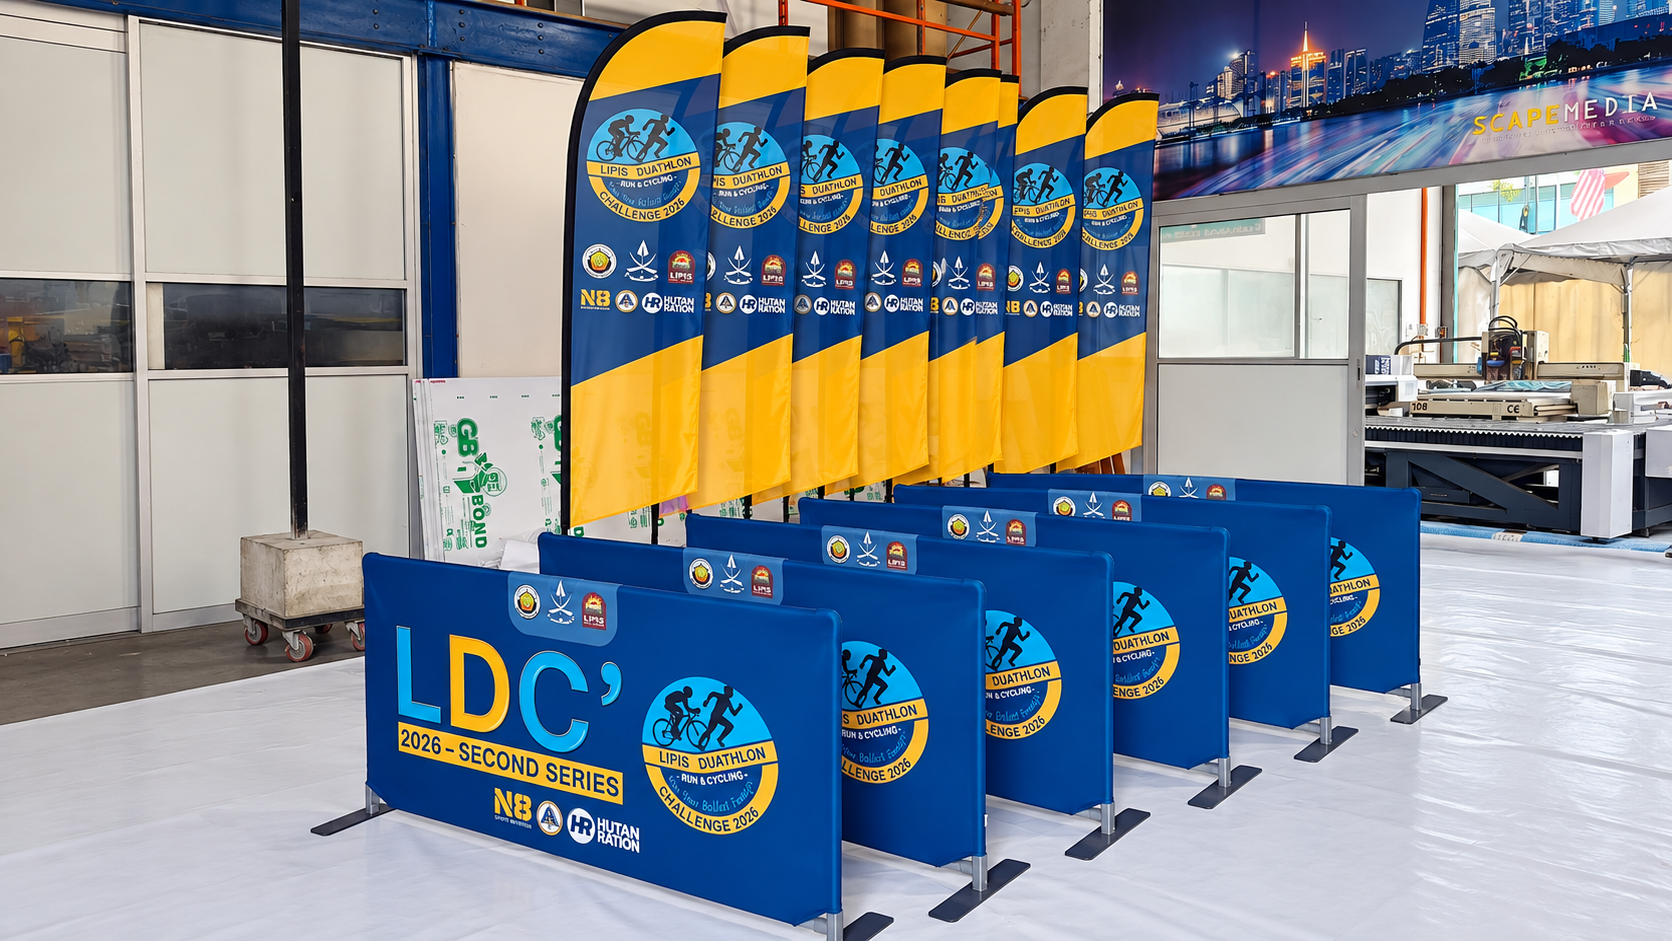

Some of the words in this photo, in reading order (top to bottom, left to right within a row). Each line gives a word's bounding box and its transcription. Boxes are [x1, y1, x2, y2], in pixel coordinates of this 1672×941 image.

[1472, 91, 1658, 135] SCAPEMEDIA
[600, 165, 628, 176] LIPIS
[636, 156, 692, 176] DUATHLON
[732, 166, 782, 186] DUATHLON
[812, 177, 857, 194] DUATHLON
[600, 191, 662, 220] CHALLENGE
[663, 197, 685, 217] 2026
[581, 289, 610, 306] N8
[645, 297, 660, 308] HR
[664, 296, 694, 306] HUTAN
[664, 304, 694, 313] RATION
[742, 299, 756, 309] HR
[758, 297, 785, 306] HUTAN
[816, 301, 828, 311] HR
[886, 298, 899, 307] HR
[472, 495, 487, 548] BOND
[1346, 616, 1366, 632] 2026
[1252, 642, 1273, 660] 2026
[992, 666, 1051, 686] DUATHLON
[1142, 676, 1164, 695] 2026
[856, 704, 918, 725] DUATHLON
[1022, 715, 1045, 735] 2026
[400, 729, 441, 755] 2026
[459, 742, 539, 778] SECOND
[546, 762, 619, 797] SERIES
[659, 751, 690, 768] LIPIS
[698, 747, 766, 770] DUATHLON
[888, 757, 911, 779] 2026
[494, 787, 532, 821] N8
[570, 814, 592, 836] HR
[597, 817, 640, 840] HUTAN
[659, 786, 731, 832] CHALLENGE
[733, 806, 759, 830] 2026
[597, 831, 640, 853] RATION
